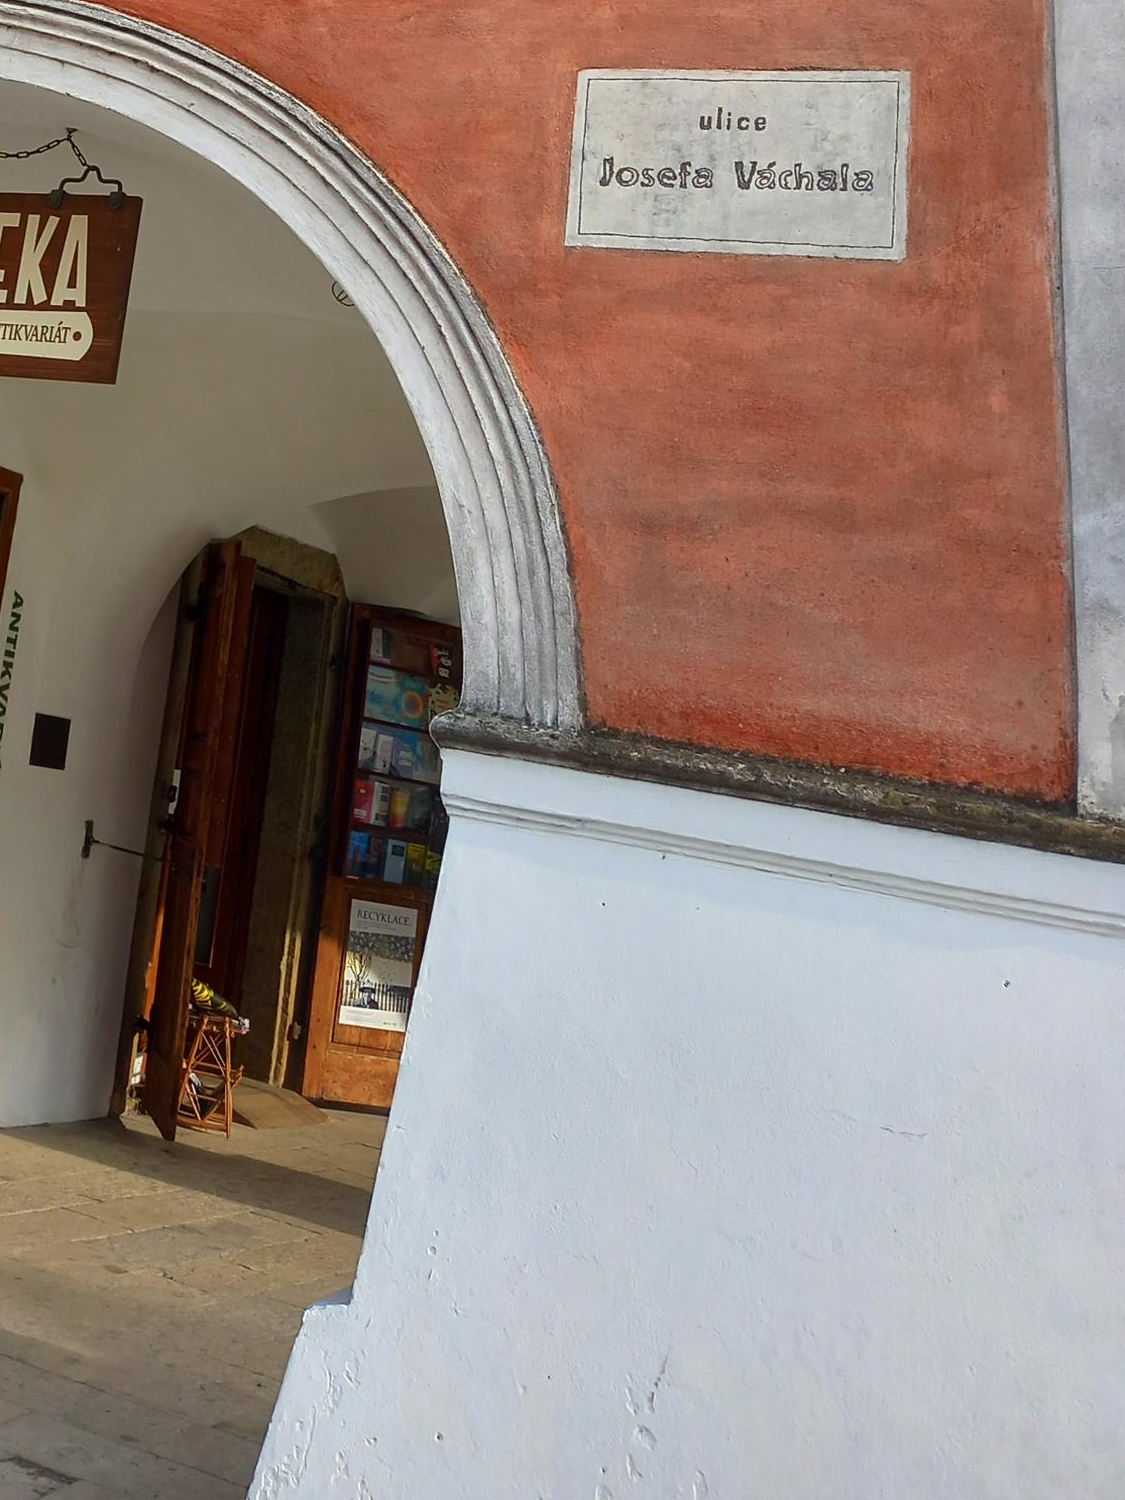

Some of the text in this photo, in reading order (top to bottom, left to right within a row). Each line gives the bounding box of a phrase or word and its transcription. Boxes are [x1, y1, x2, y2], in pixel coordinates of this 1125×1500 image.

[699, 107, 767, 132] ulice
[599, 156, 875, 192] Josefa Váchala
